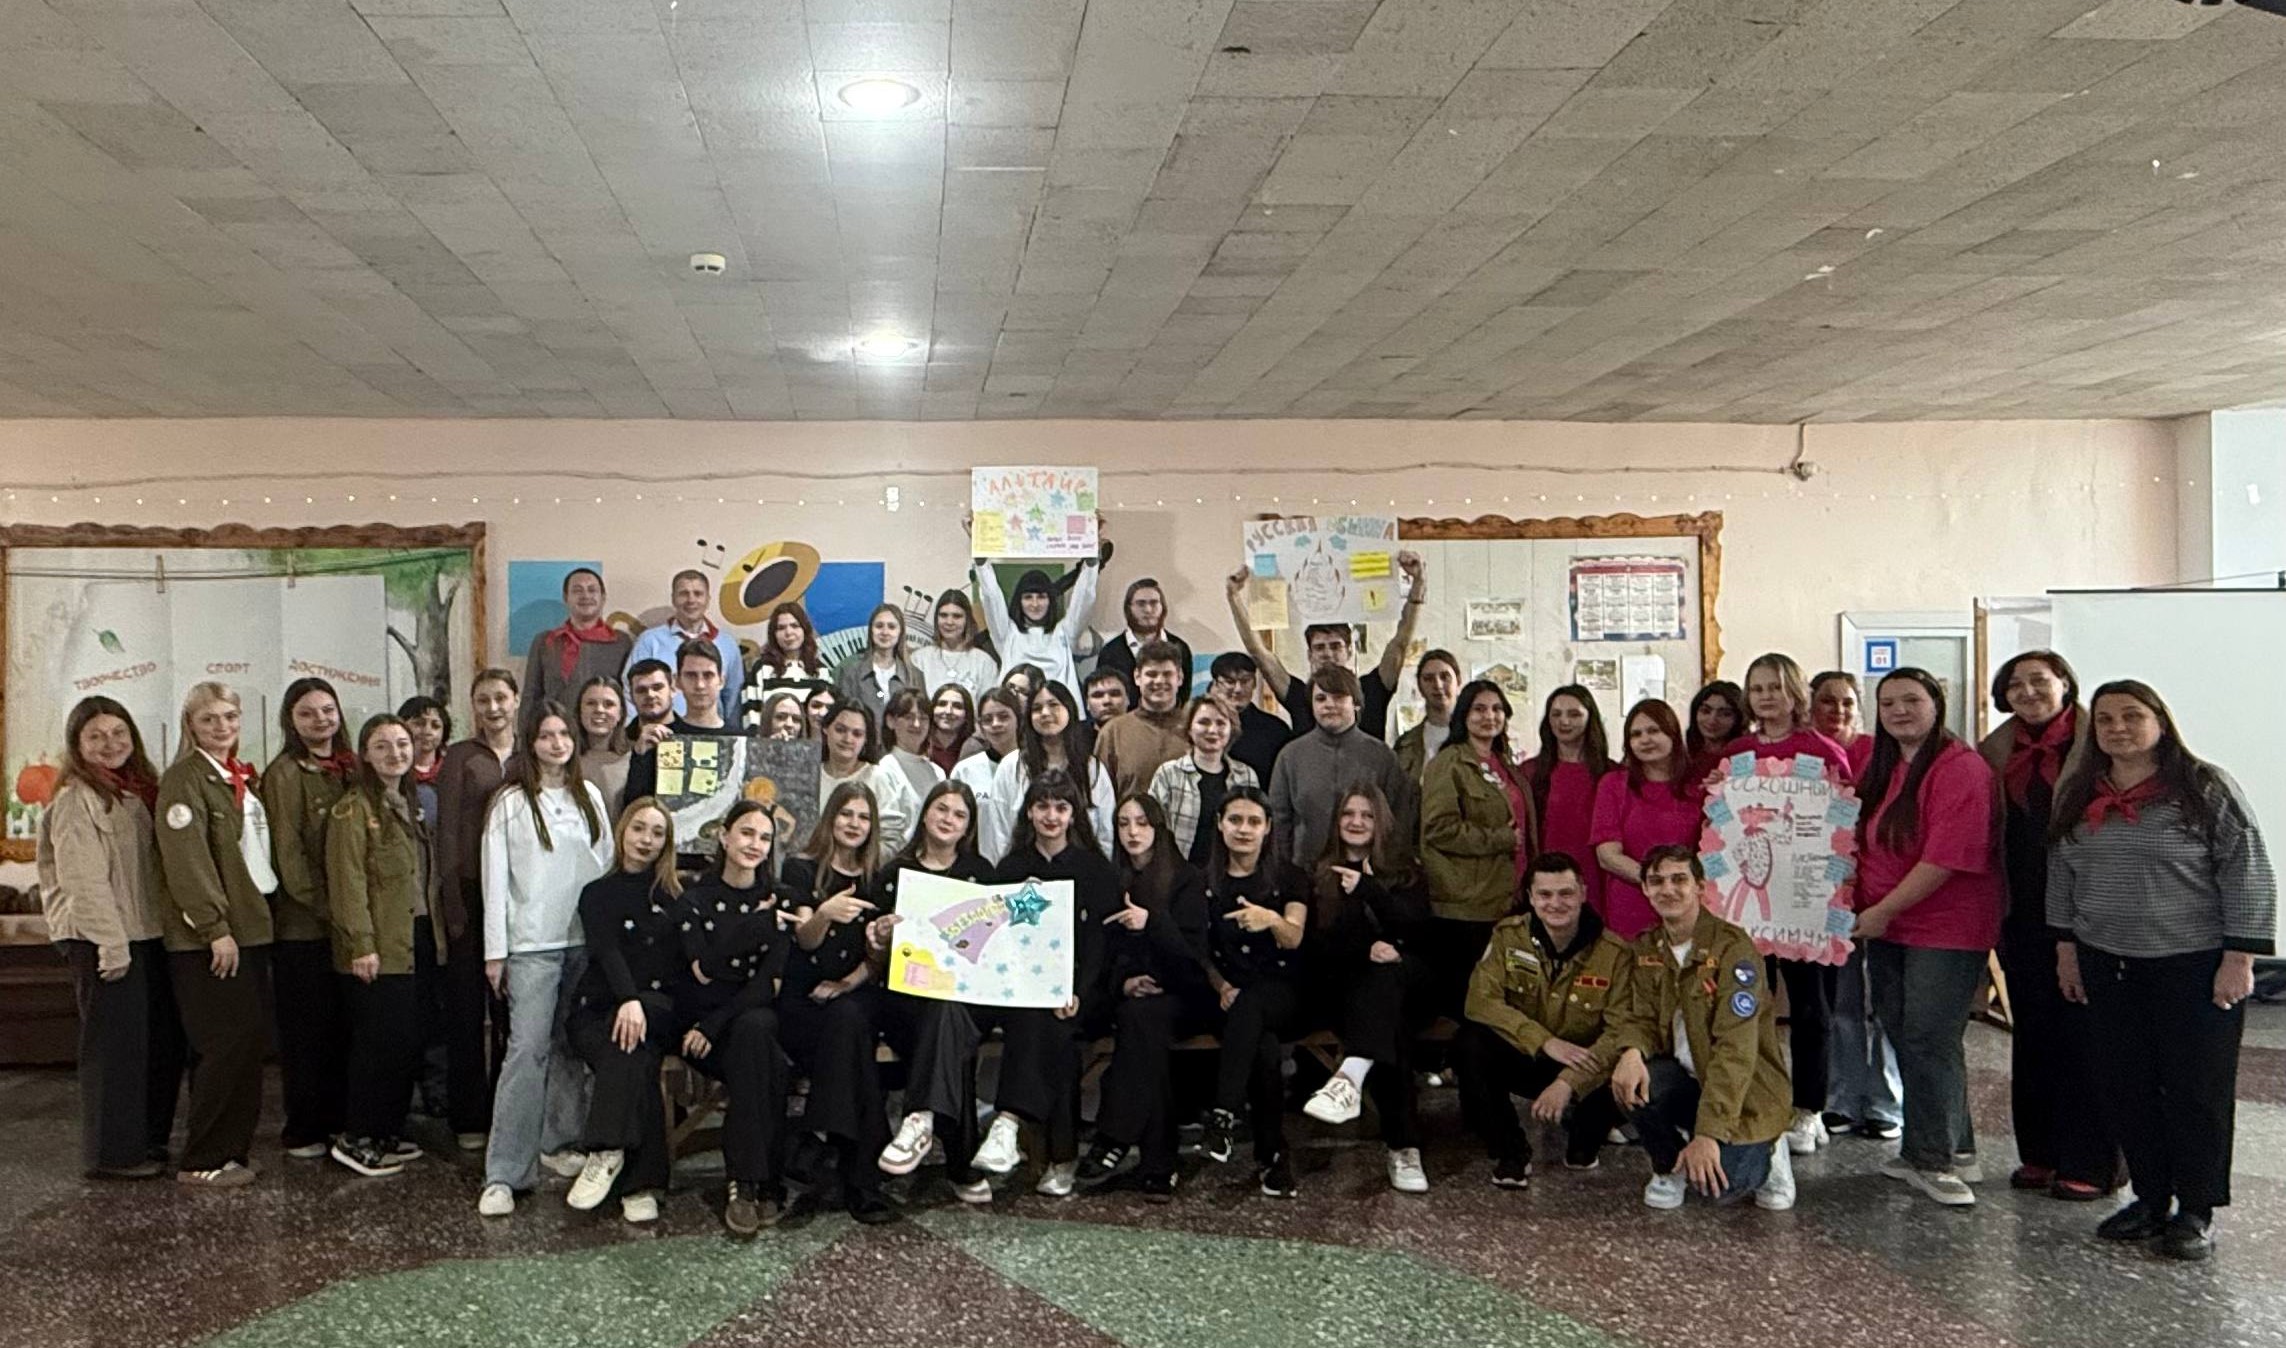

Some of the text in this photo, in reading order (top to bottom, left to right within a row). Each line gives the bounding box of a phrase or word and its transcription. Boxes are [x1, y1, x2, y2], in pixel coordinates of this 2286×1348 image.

[74, 661, 157, 691] ТВОРЧЕСТВО
[206, 662, 250, 675] СПОРТ
[288, 657, 381, 687] ДОСТИЖЕНИЯ
